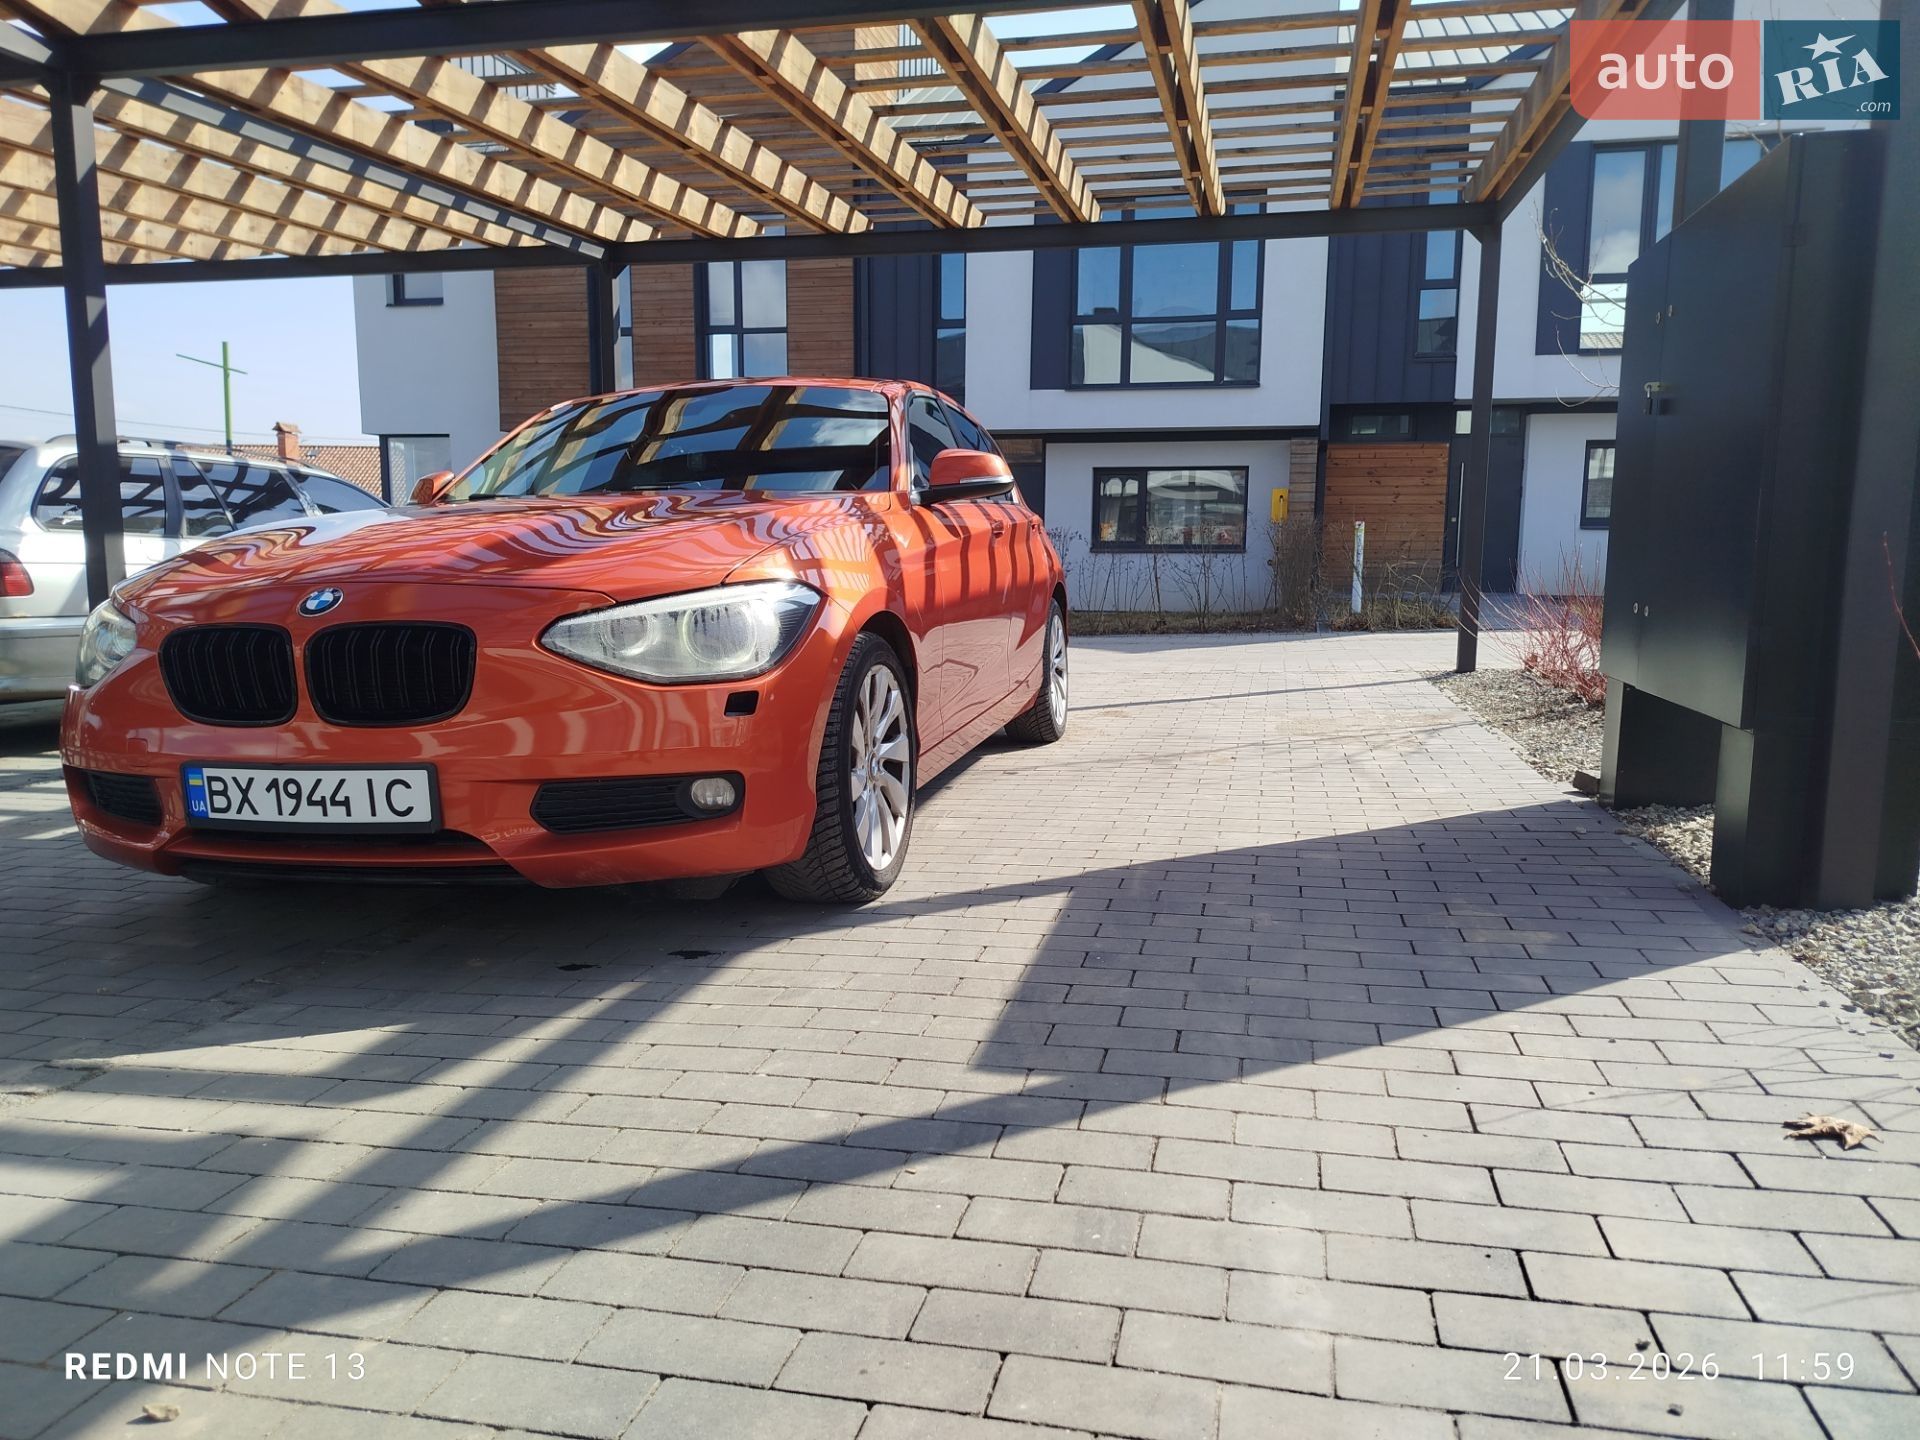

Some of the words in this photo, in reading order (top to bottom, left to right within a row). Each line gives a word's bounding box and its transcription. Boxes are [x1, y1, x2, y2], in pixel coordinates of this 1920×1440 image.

[191, 799, 207, 812] UA
[206, 775, 259, 815] BX
[265, 778, 352, 817] 1944
[367, 778, 414, 817] IC
